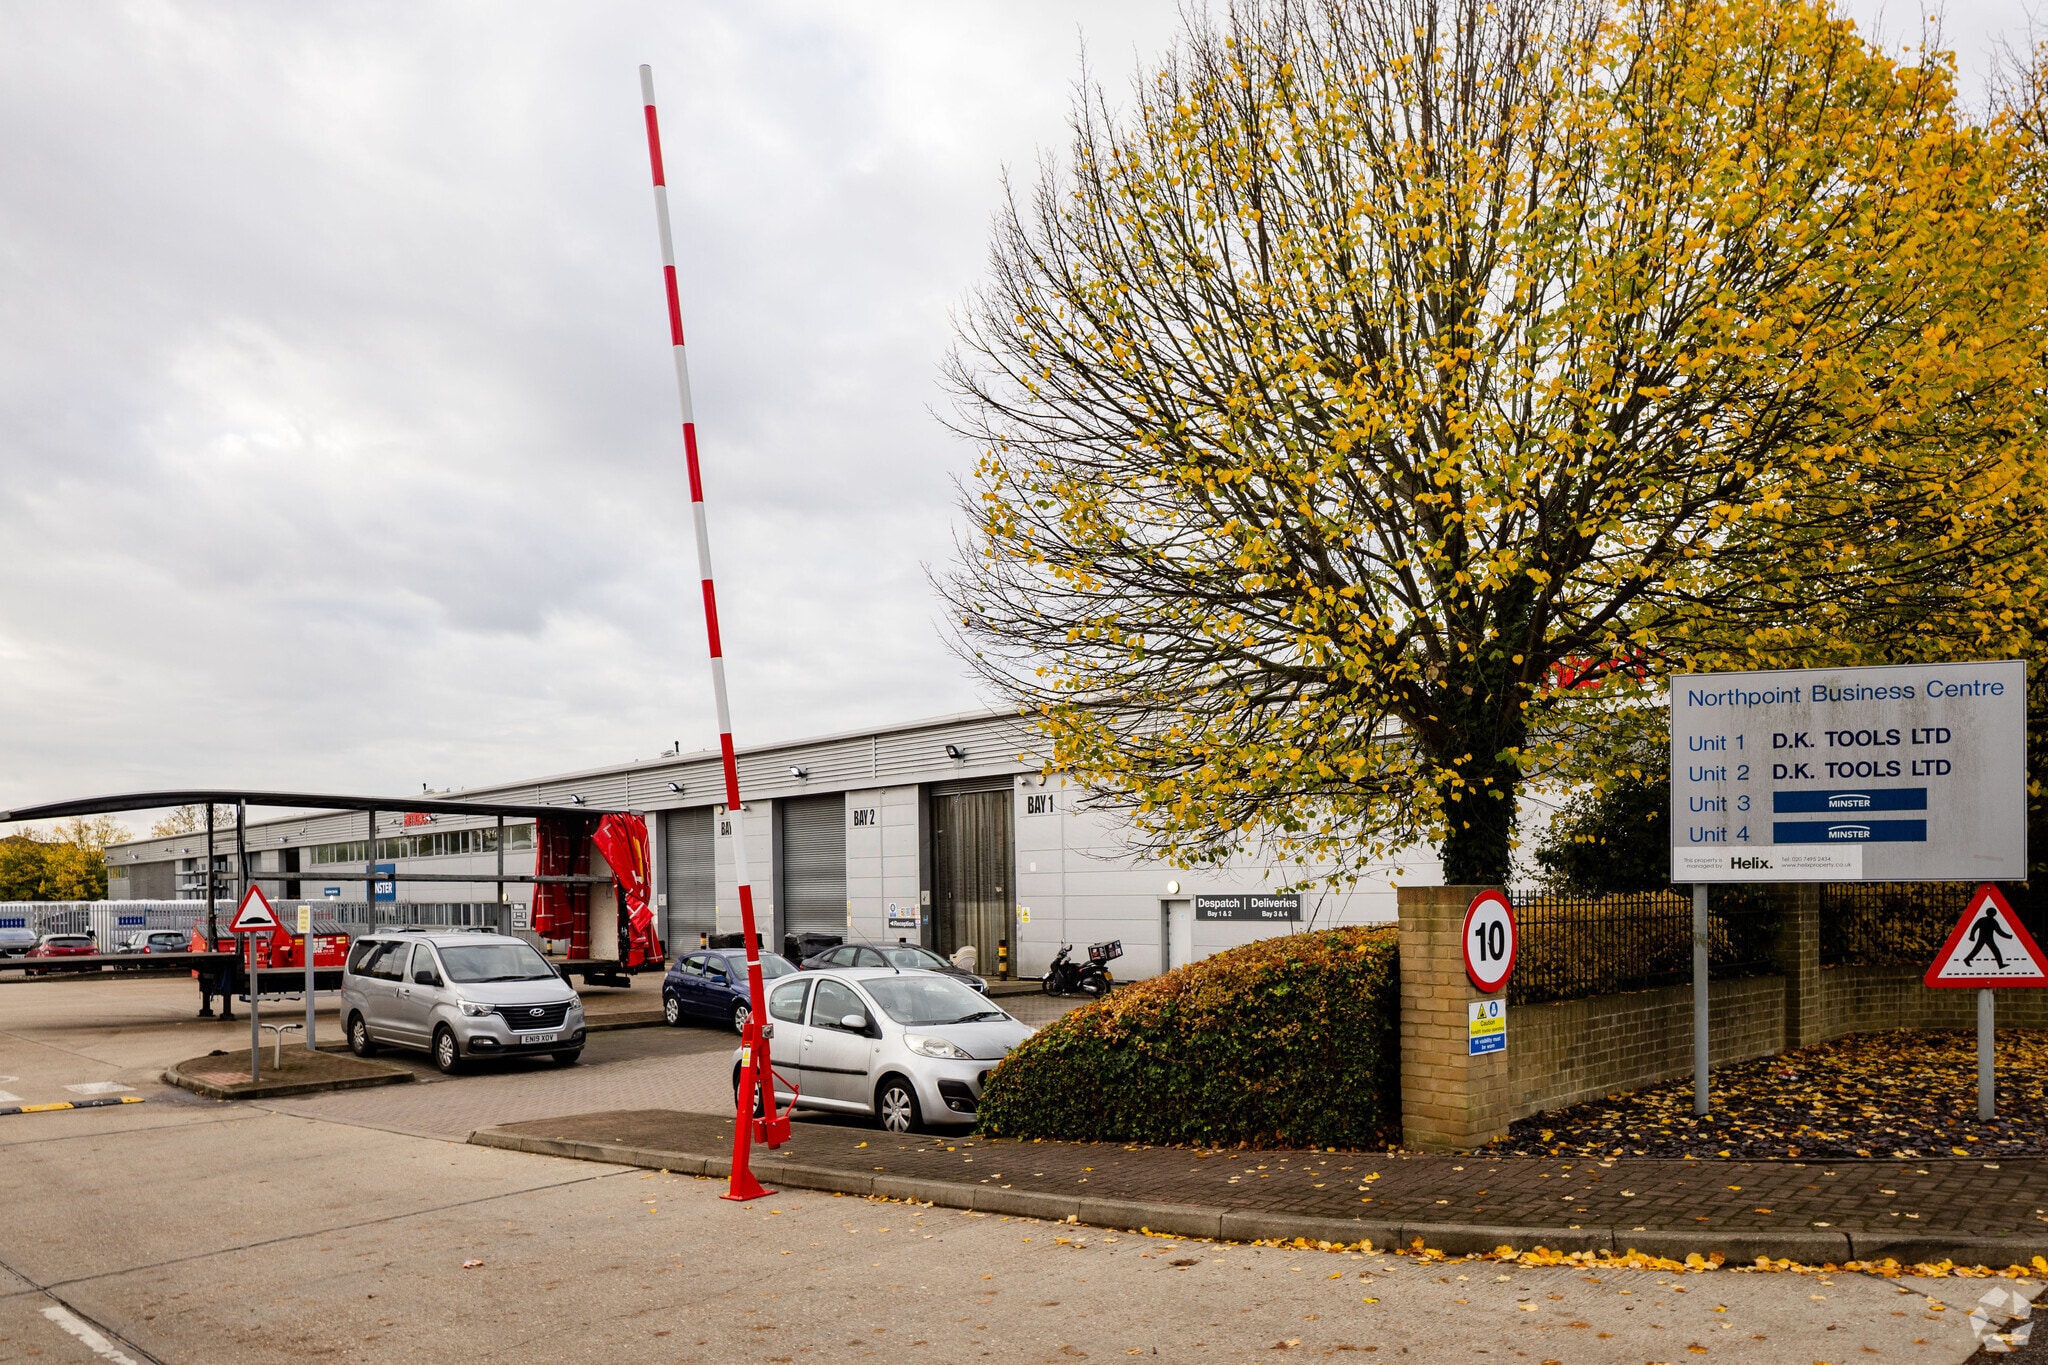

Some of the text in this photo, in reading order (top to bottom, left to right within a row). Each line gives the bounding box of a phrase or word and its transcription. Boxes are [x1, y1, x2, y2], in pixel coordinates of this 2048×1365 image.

[1688, 679, 2004, 708] Northpoint Business Centre
[1689, 727, 1951, 751] Unit 1 D.K. TOOLS LTD
[1689, 759, 1951, 782] Unit 2 D.K. TOOLS LTD
[1027, 794, 1053, 814] BAY 1
[1689, 795, 1870, 812] Unit 3 MINSTER
[854, 808, 875, 826] BAY 2
[1689, 826, 1870, 842] Unit 4 MINSTER
[1730, 857, 1773, 869] Helix.
[1198, 898, 1240, 909] Despatch
[1251, 898, 1297, 908] Deliveries
[1475, 920, 1505, 961] 10
[525, 1035, 540, 1043] EN19
